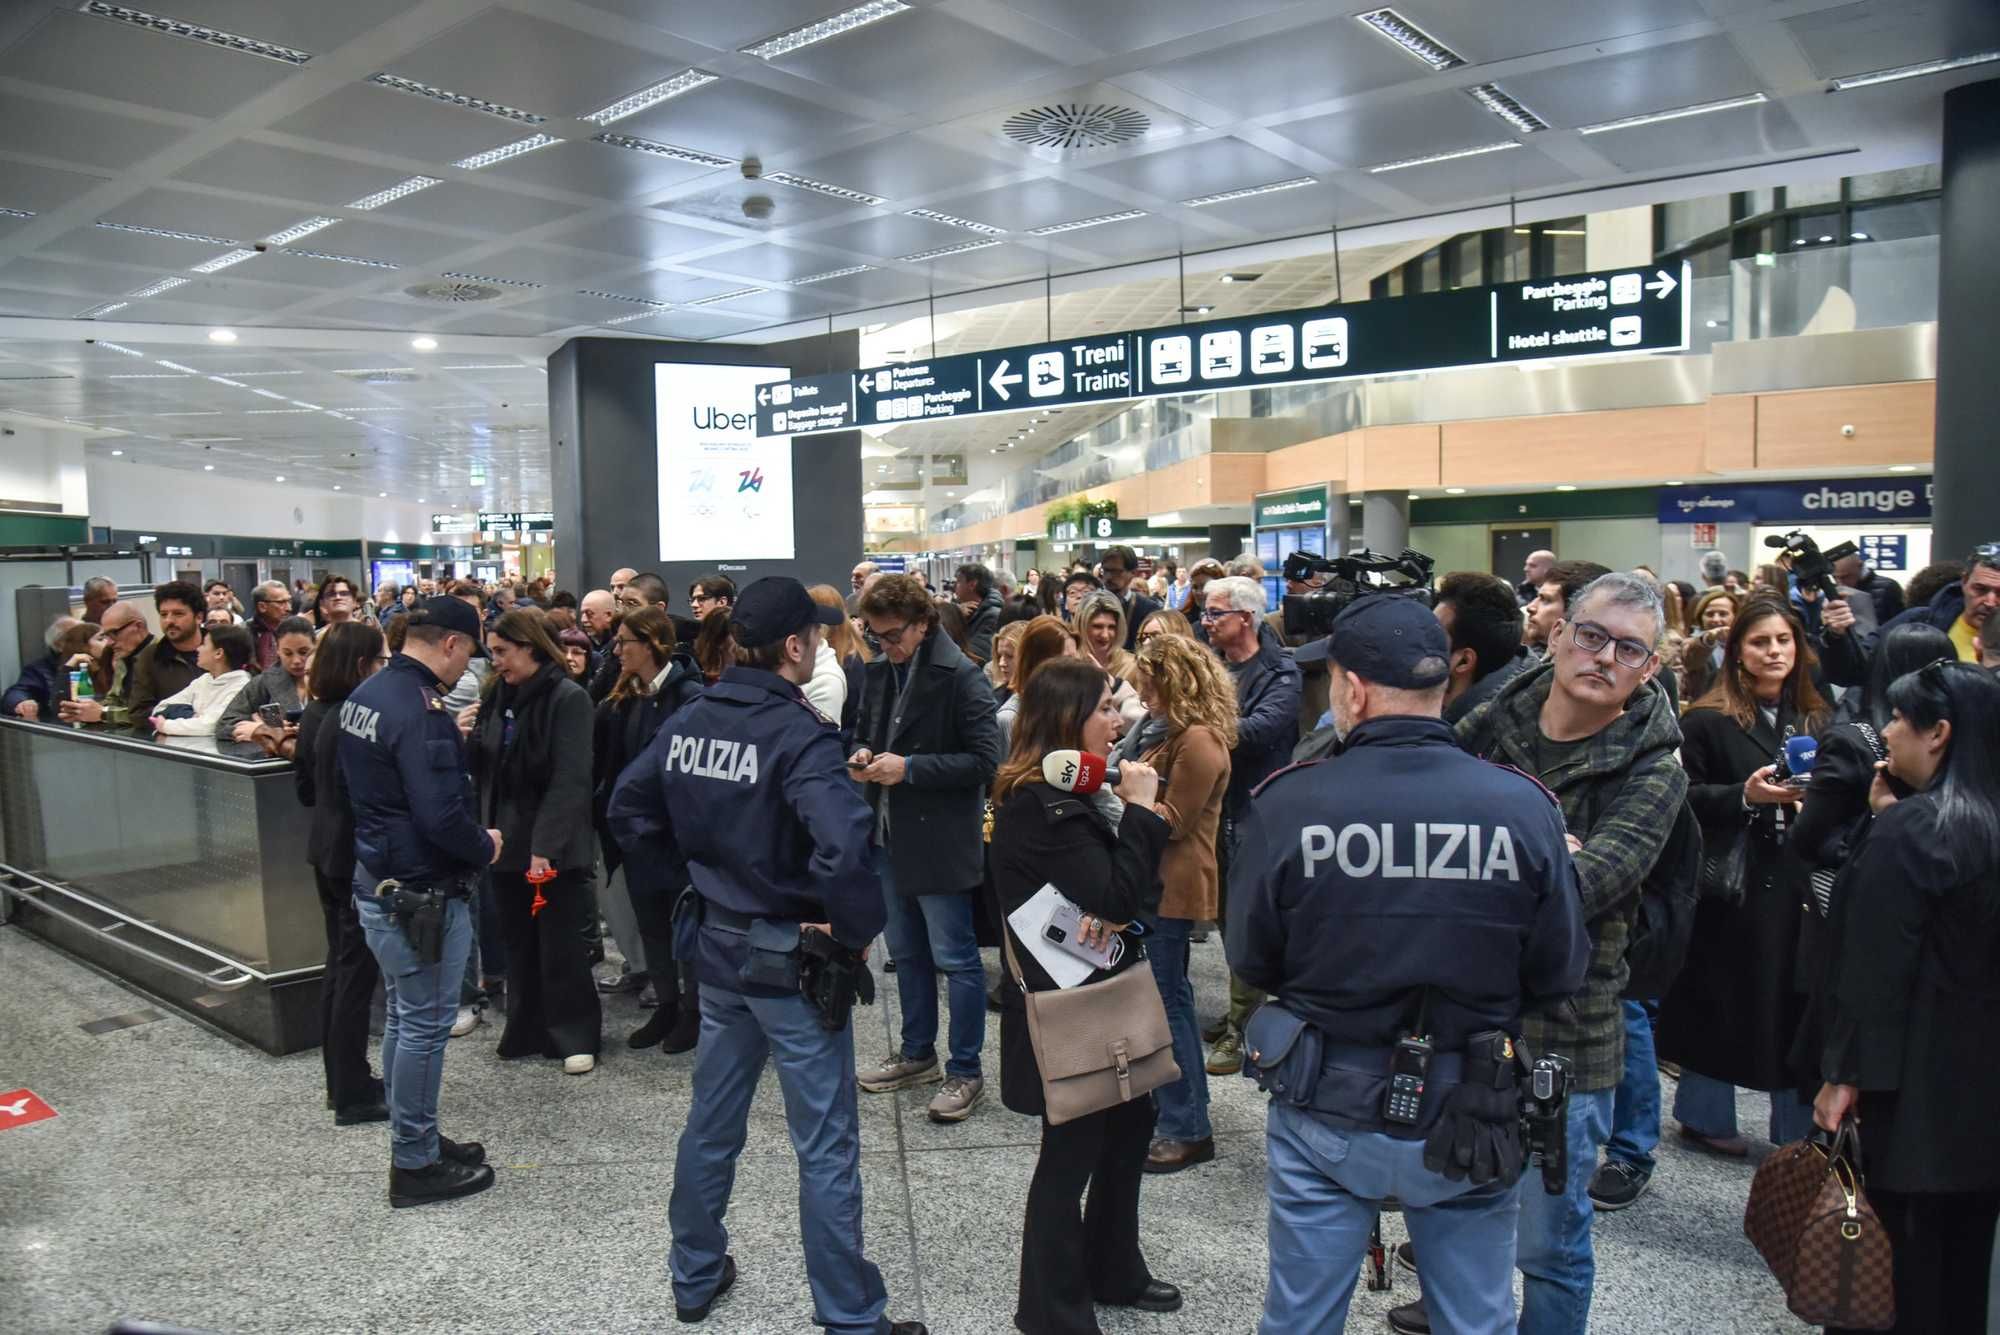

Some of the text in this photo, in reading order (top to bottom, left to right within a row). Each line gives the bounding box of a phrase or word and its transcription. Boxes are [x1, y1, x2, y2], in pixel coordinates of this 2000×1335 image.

[1522, 277, 1607, 301] Parcheggio
[1553, 294, 1607, 311] Parking
[1508, 326, 1607, 349] Hotel shuttle
[1072, 338, 1125, 367] Treni
[893, 377, 936, 391] Departures
[1072, 369, 1129, 393] Trains
[924, 388, 972, 403] Parcheggio
[693, 406, 757, 430] Uber
[924, 403, 954, 416] Parking
[1802, 487, 1915, 512] change
[1097, 518, 1112, 537] 8
[665, 734, 758, 784] POLIZIA
[1061, 760, 1077, 784] sky
[1301, 823, 1520, 881] POLIZIA
